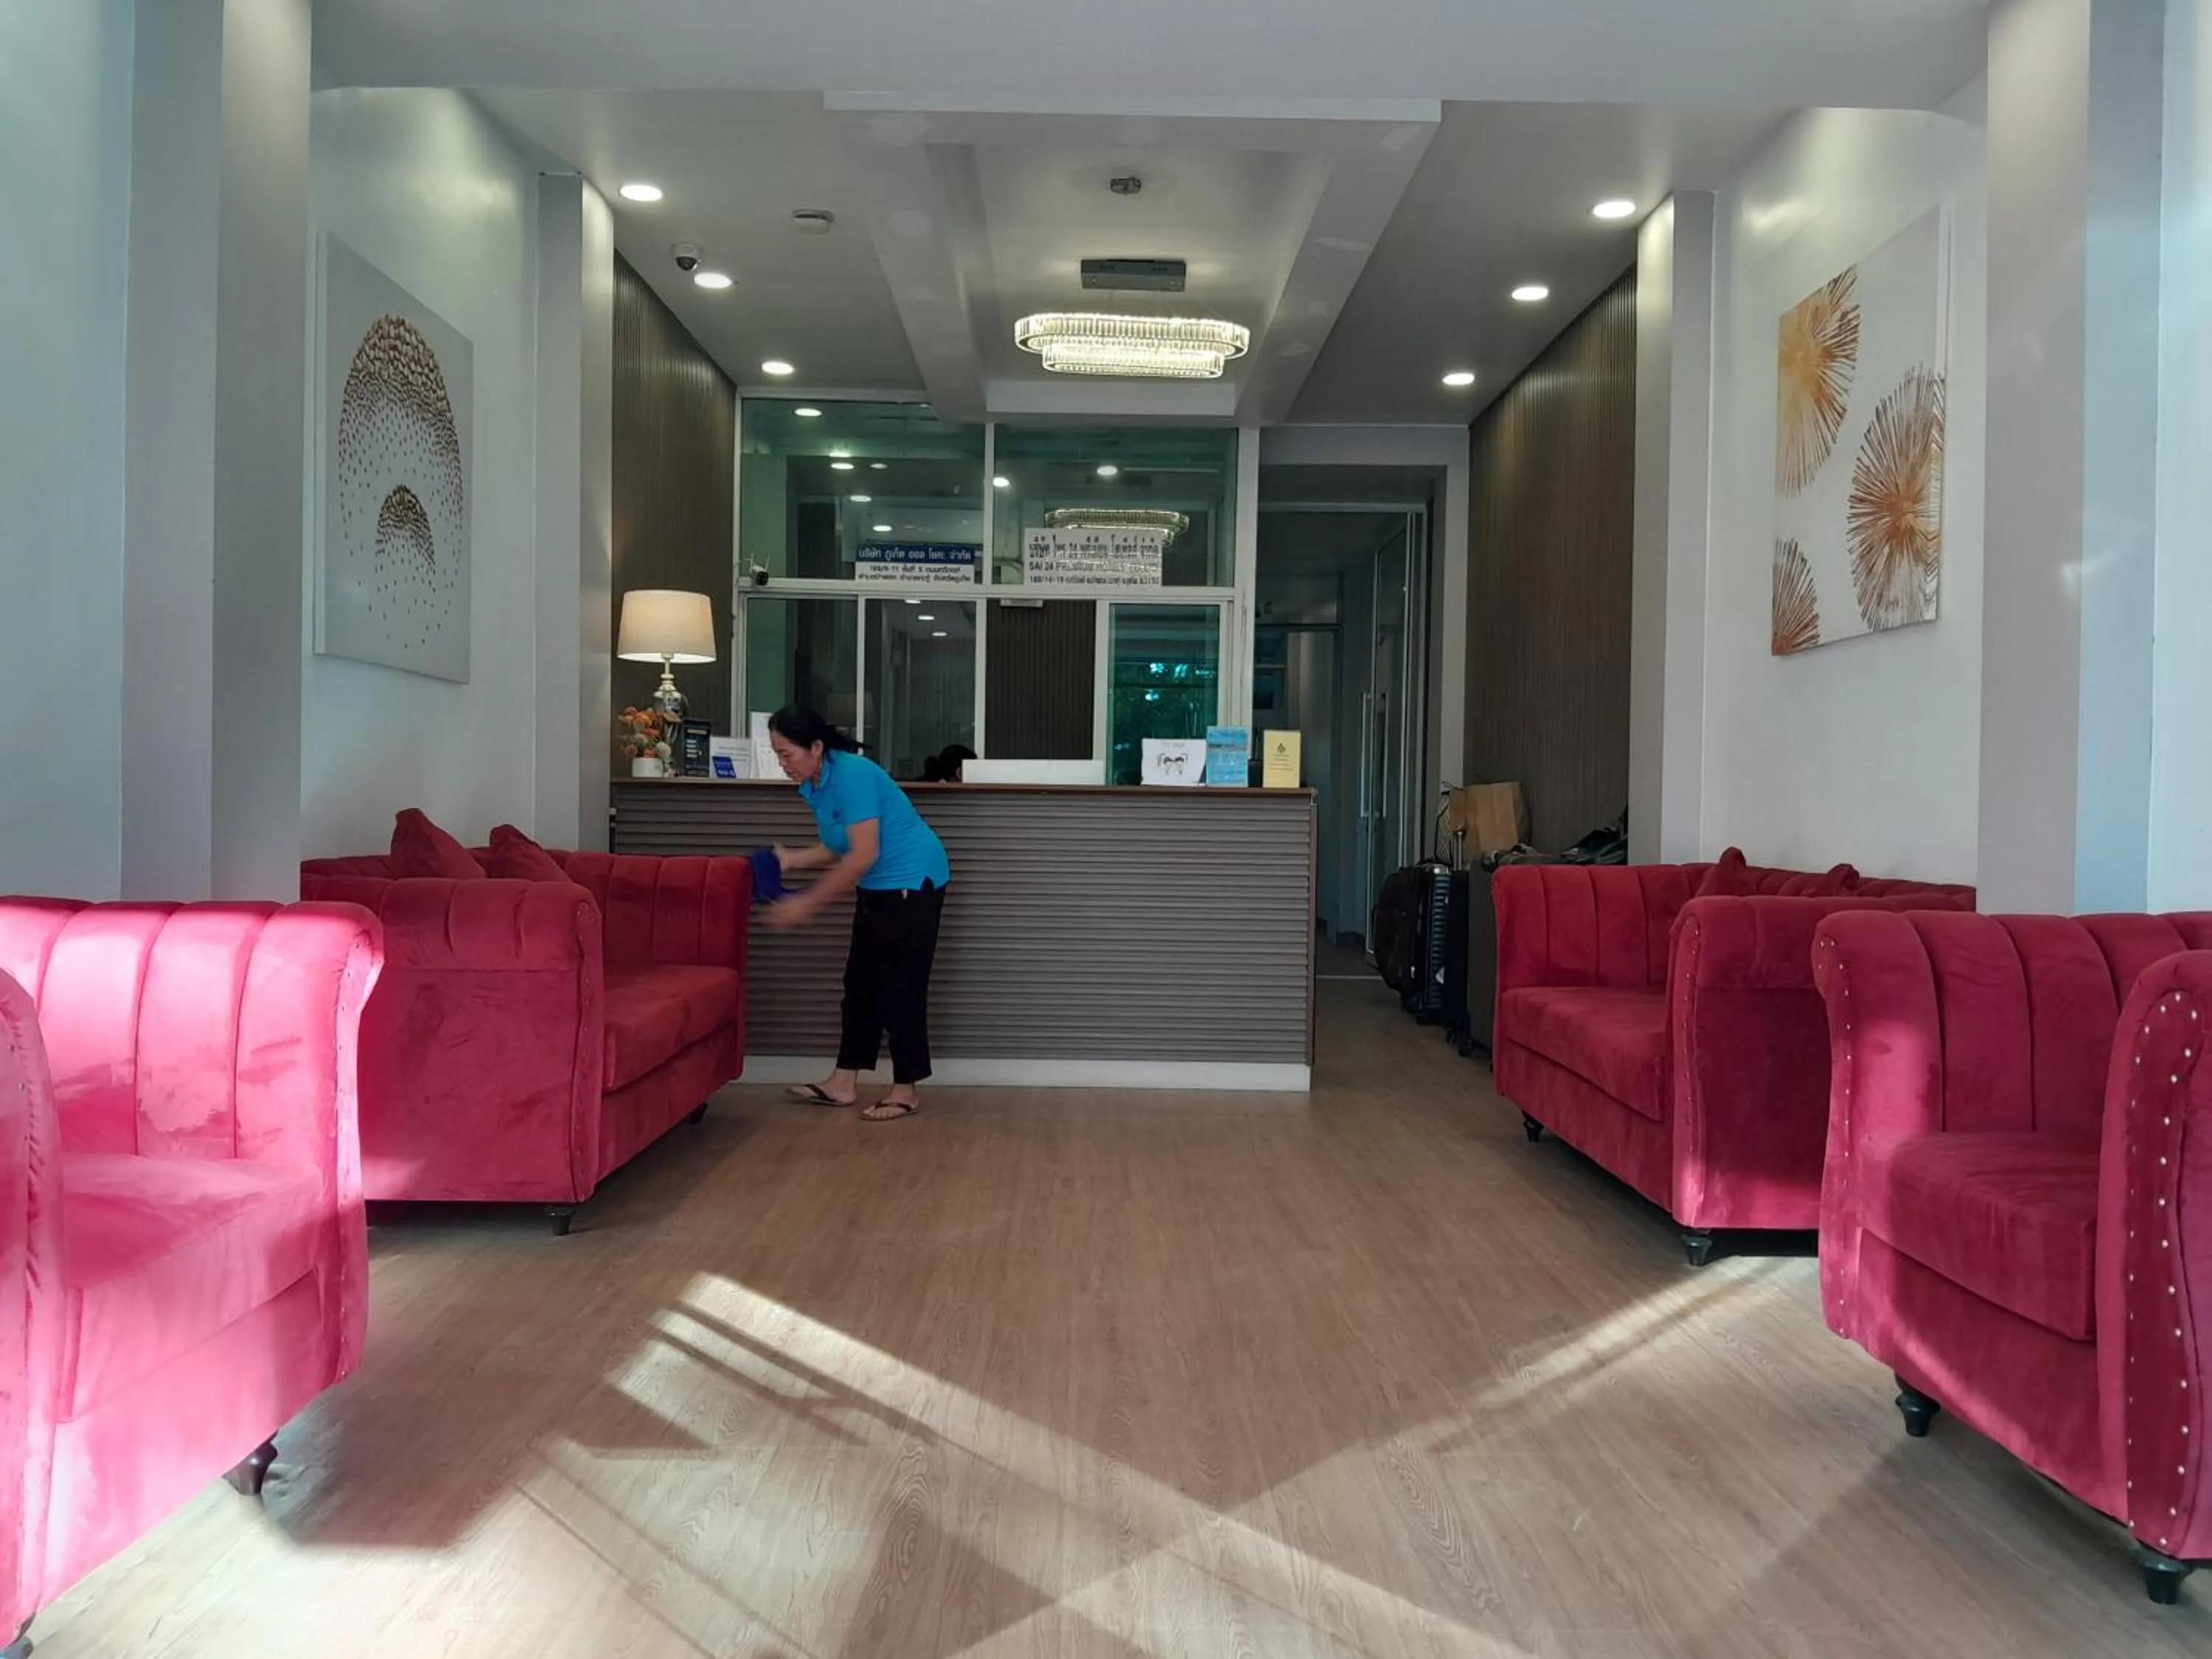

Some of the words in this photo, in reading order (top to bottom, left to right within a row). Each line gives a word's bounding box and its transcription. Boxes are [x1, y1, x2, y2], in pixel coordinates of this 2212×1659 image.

[859, 546, 881, 558] บริษัท
[949, 549, 971, 560] จำกัด
[1029, 561, 1043, 571] SAI
[1044, 561, 1054, 571] 24
